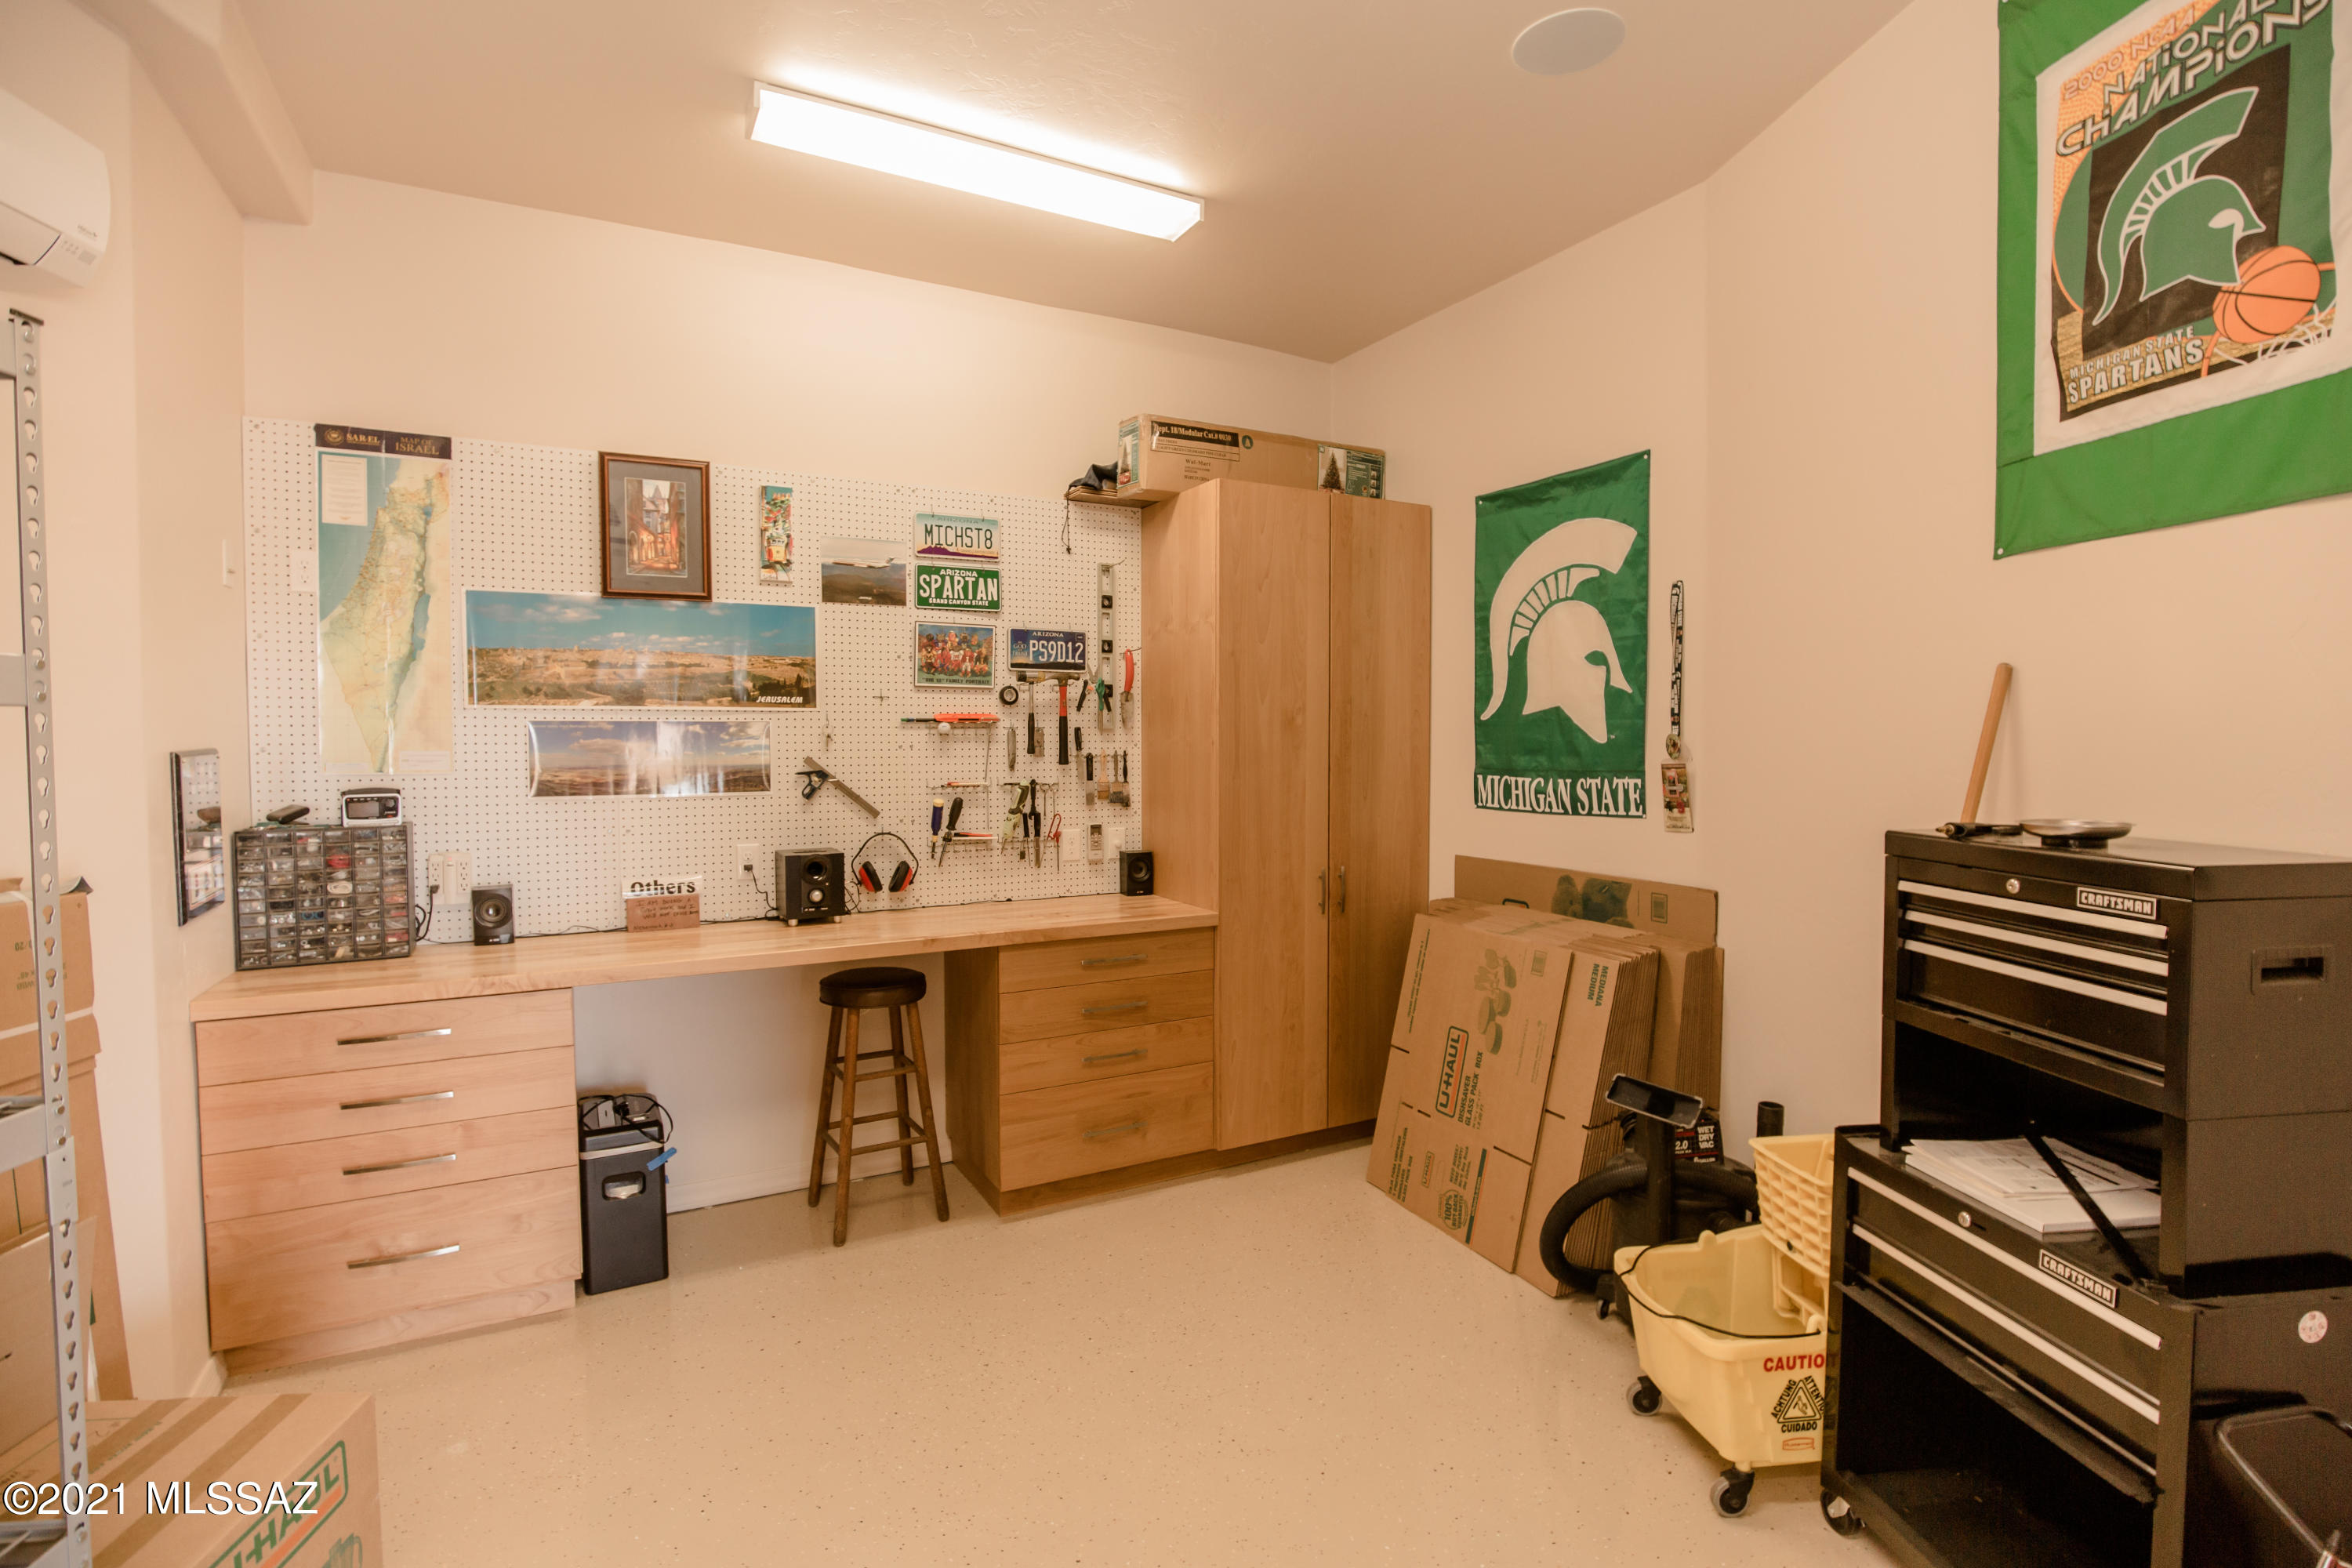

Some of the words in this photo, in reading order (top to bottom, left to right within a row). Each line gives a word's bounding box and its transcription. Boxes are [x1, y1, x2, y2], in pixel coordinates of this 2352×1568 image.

[2064, 51, 2124, 100] 2000
[2130, 6, 2194, 59] NCAA
[2069, 345, 2140, 379] MICHIGAN
[2145, 325, 2194, 352] STATE
[2067, 338, 2205, 404] SPARTANS
[395, 442, 439, 455] ISRAEL
[924, 524, 993, 550] MICHST8
[919, 574, 998, 601] SPARTAN
[756, 695, 804, 704] JERUSALEM
[1477, 775, 1573, 815] MICHIGAN
[1577, 775, 1643, 816] STATE
[630, 880, 696, 897] Others
[2080, 891, 2152, 916] CRAFTSMAN
[1587, 963, 1600, 1000] MEDIUM
[1595, 966, 1609, 1007] MEDIANA
[1439, 1034, 1461, 1109] U-HAUL
[1457, 1075, 1472, 1123] DISHSAVER
[1465, 1097, 1475, 1127] GLASS
[1470, 1073, 1479, 1096] PACK
[1475, 1051, 1484, 1069] BOX
[1675, 1140, 1689, 1150] 2.0
[1699, 1133, 1715, 1142] DRY
[1444, 1195, 1453, 1221] 100%
[2042, 1256, 2112, 1301] CRAFTSMAN
[1763, 1353, 1825, 1373] CAUTIO
[1771, 1379, 1796, 1418] ACHTUNG
[1781, 1421, 1817, 1433] CUIDADO
